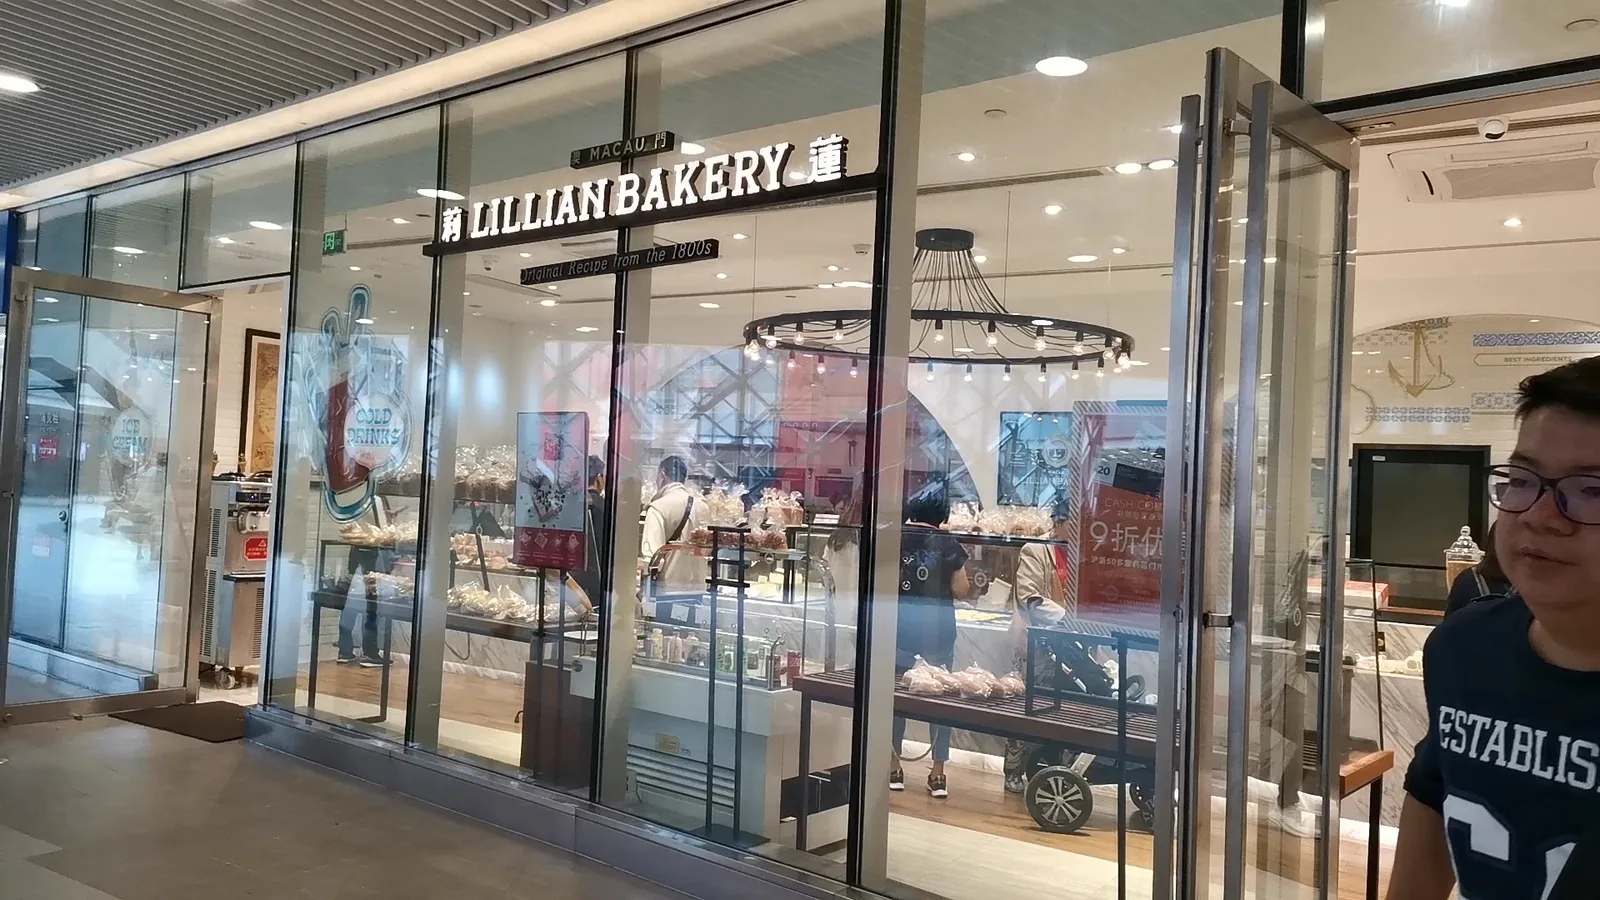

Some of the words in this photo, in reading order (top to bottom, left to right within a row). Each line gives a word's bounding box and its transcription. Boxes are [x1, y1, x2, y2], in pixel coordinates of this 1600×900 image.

[590, 137, 645, 162] MACAU
[654, 132, 667, 149] 門
[441, 205, 463, 243] 莉
[470, 177, 609, 239] LILLIAN
[615, 142, 790, 216] BAKERY
[807, 133, 845, 183] 蓮
[521, 264, 563, 284] Original
[568, 256, 608, 276] Recipe
[612, 252, 640, 270] from
[646, 247, 666, 263] the
[671, 239, 713, 260] 1800s
[356, 407, 392, 425] COLD
[347, 427, 401, 446] DRINKS
[1104, 497, 1134, 509] CASH
[1439, 705, 1600, 793] ESTABLIS
